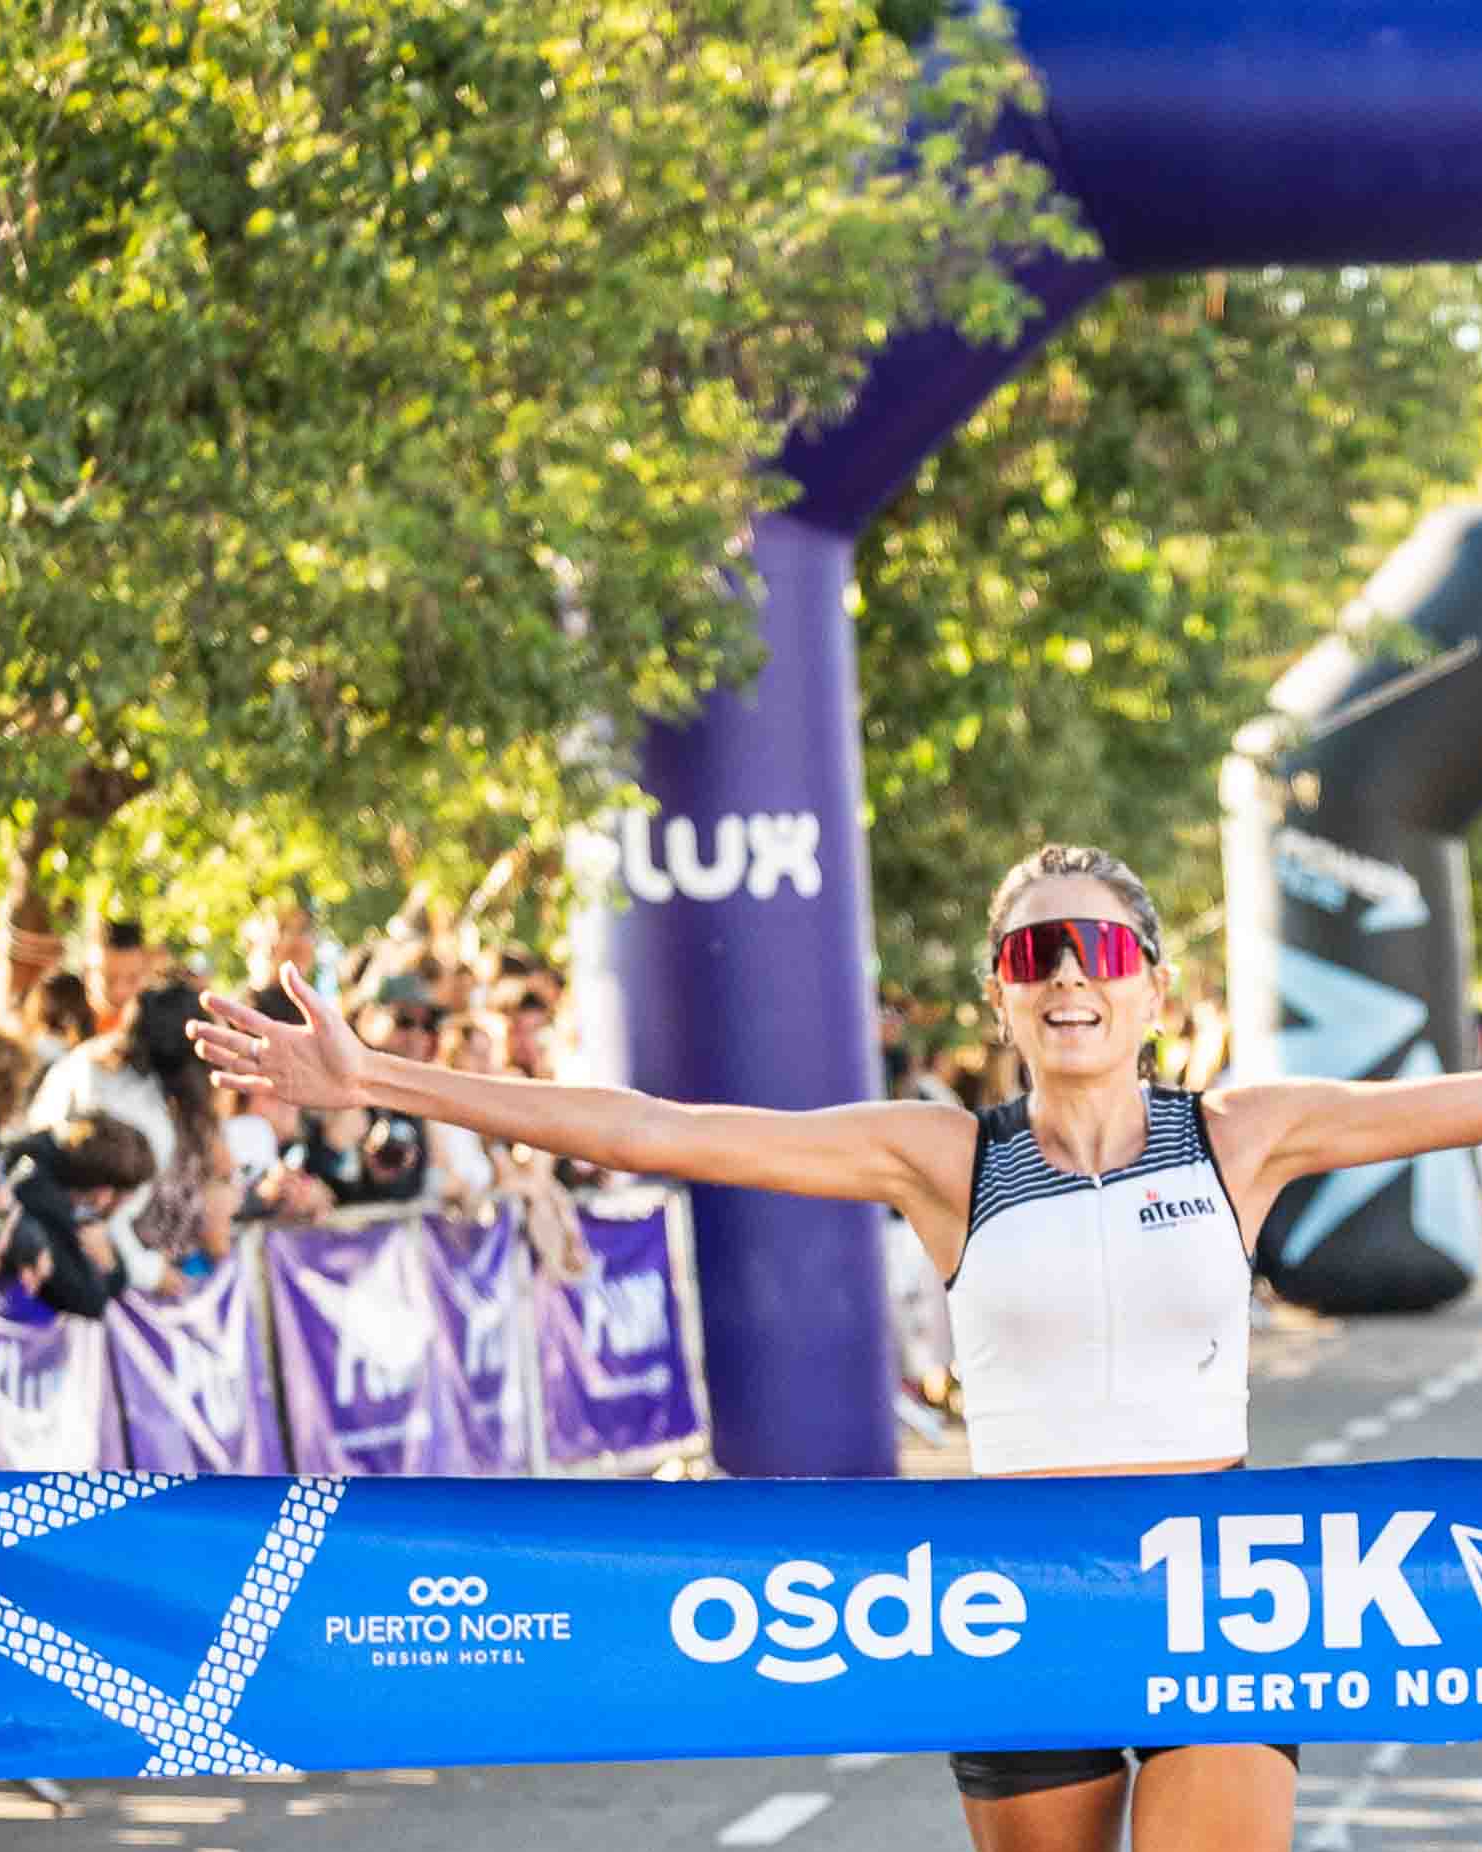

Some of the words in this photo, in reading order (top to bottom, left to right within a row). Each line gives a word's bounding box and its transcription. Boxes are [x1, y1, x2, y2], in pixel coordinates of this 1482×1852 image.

[669, 1541, 1028, 1664] osde
[1139, 1510, 1443, 1654] 15K
[326, 1613, 451, 1644] PUERTO
[460, 1612, 572, 1641] NORTE
[371, 1651, 450, 1667] DESIGN
[459, 1649, 526, 1665] HOTEL
[1146, 1671, 1371, 1715] PUERTO
